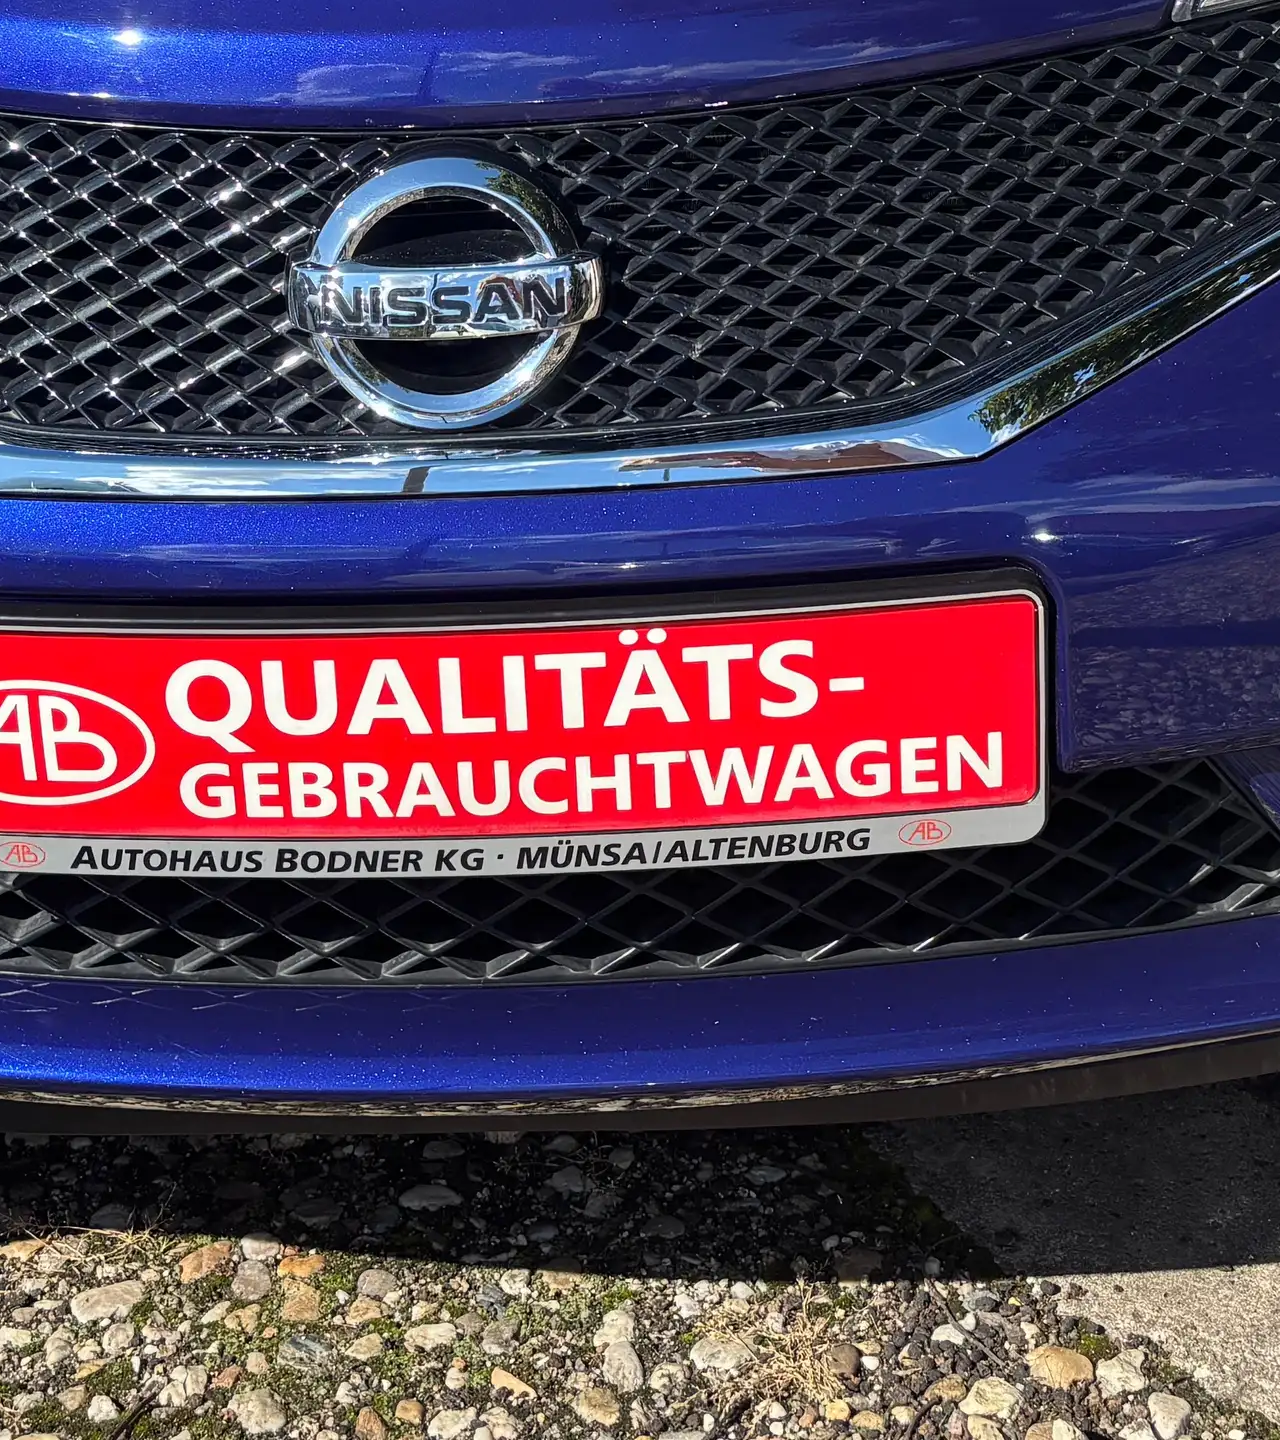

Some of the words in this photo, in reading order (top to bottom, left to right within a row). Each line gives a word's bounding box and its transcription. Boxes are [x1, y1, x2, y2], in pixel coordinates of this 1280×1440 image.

[318, 274, 571, 328] NISSAN
[164, 627, 865, 754] QUALITÄTS-
[178, 731, 1003, 819] GEBRAUCHTWAGEN
[69, 844, 263, 873] AUTOHAUS
[274, 847, 422, 873] BODNER
[434, 848, 485, 872] KG
